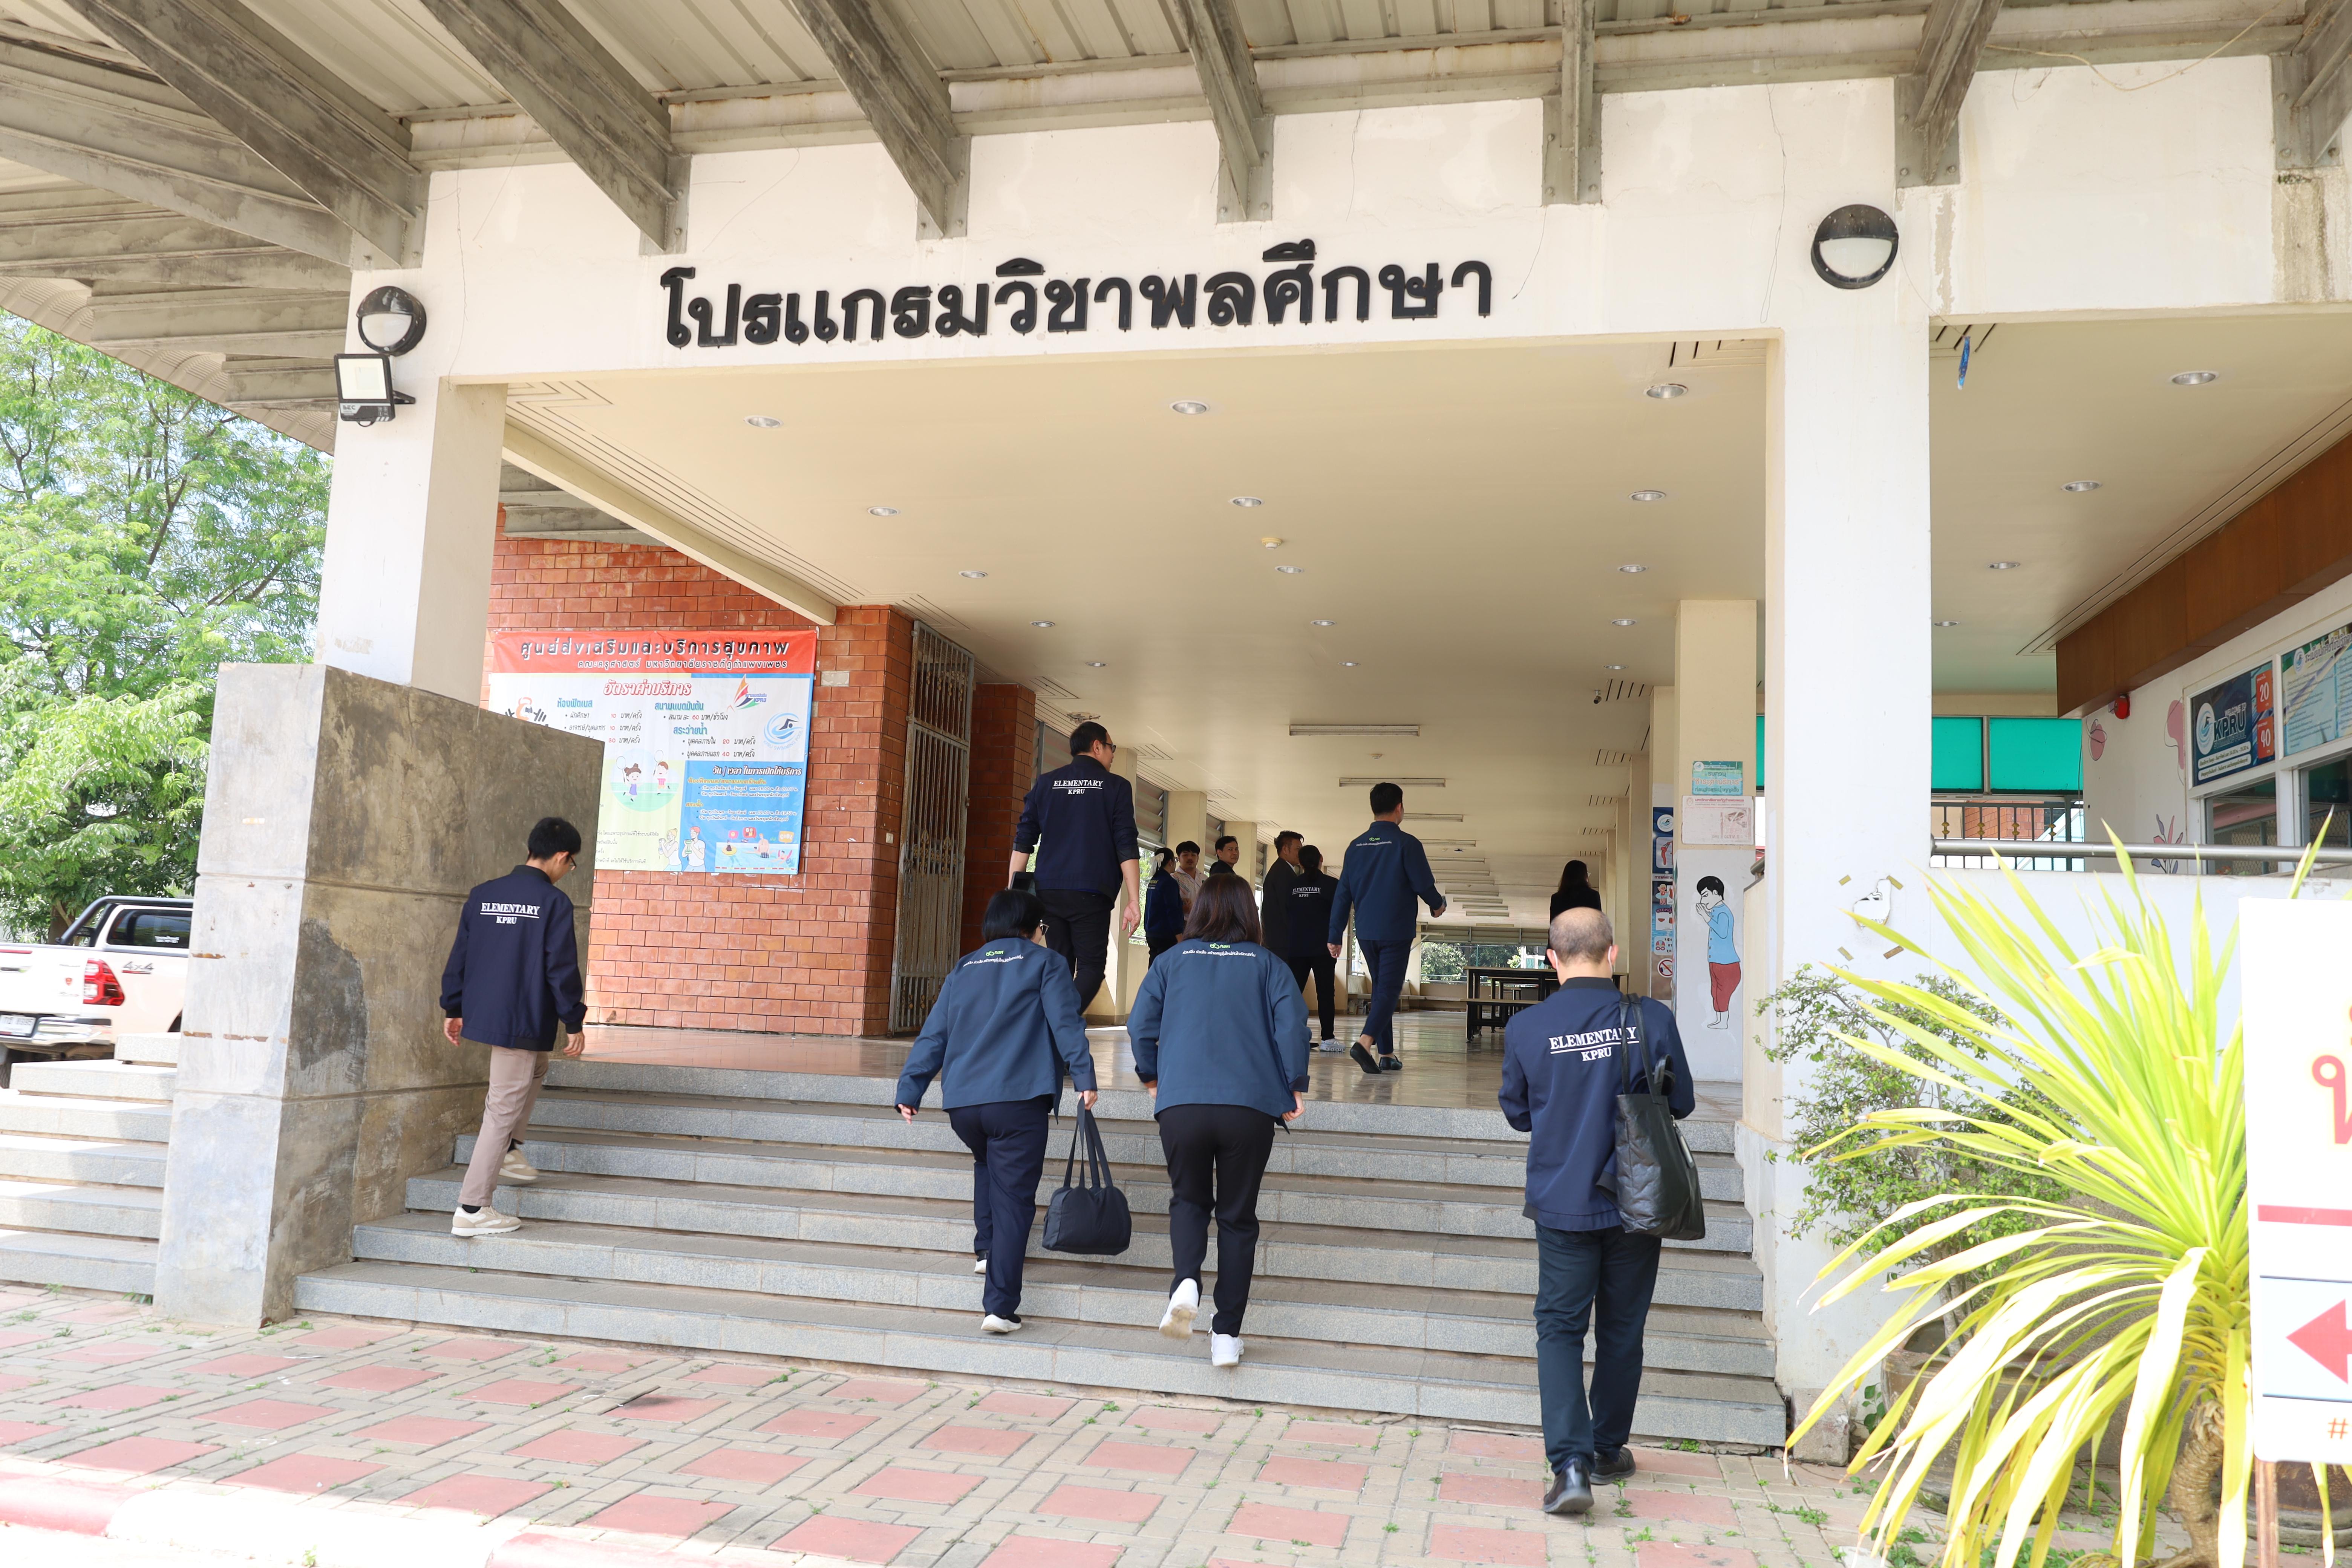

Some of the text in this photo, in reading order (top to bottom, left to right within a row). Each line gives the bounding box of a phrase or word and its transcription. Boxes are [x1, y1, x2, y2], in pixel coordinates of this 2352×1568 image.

[660, 238, 1491, 349] โปรแกรมวิชาพลศึกษา
[521, 637, 789, 660] ศูนย์ส่งเสริมและบริการสุขภาพ
[577, 658, 641, 670] คณะครุศาสตร์
[603, 679, 691, 695] อัตราค่าบริการ
[2260, 682, 2269, 702] 20
[557, 697, 593, 708] ห้องฟิตเนส
[570, 710, 590, 719] นักศึกษา
[2225, 704, 2241, 717] WELCOME
[674, 722, 707, 735] สระว่ายน้ำ
[2214, 709, 2246, 742] KPRU
[2261, 728, 2271, 747] 40
[481, 902, 540, 915] ELEMENTARY
[496, 916, 517, 924] KPRU
[123, 961, 153, 970] 4x4
[1581, 1047, 1612, 1061] KPRU
